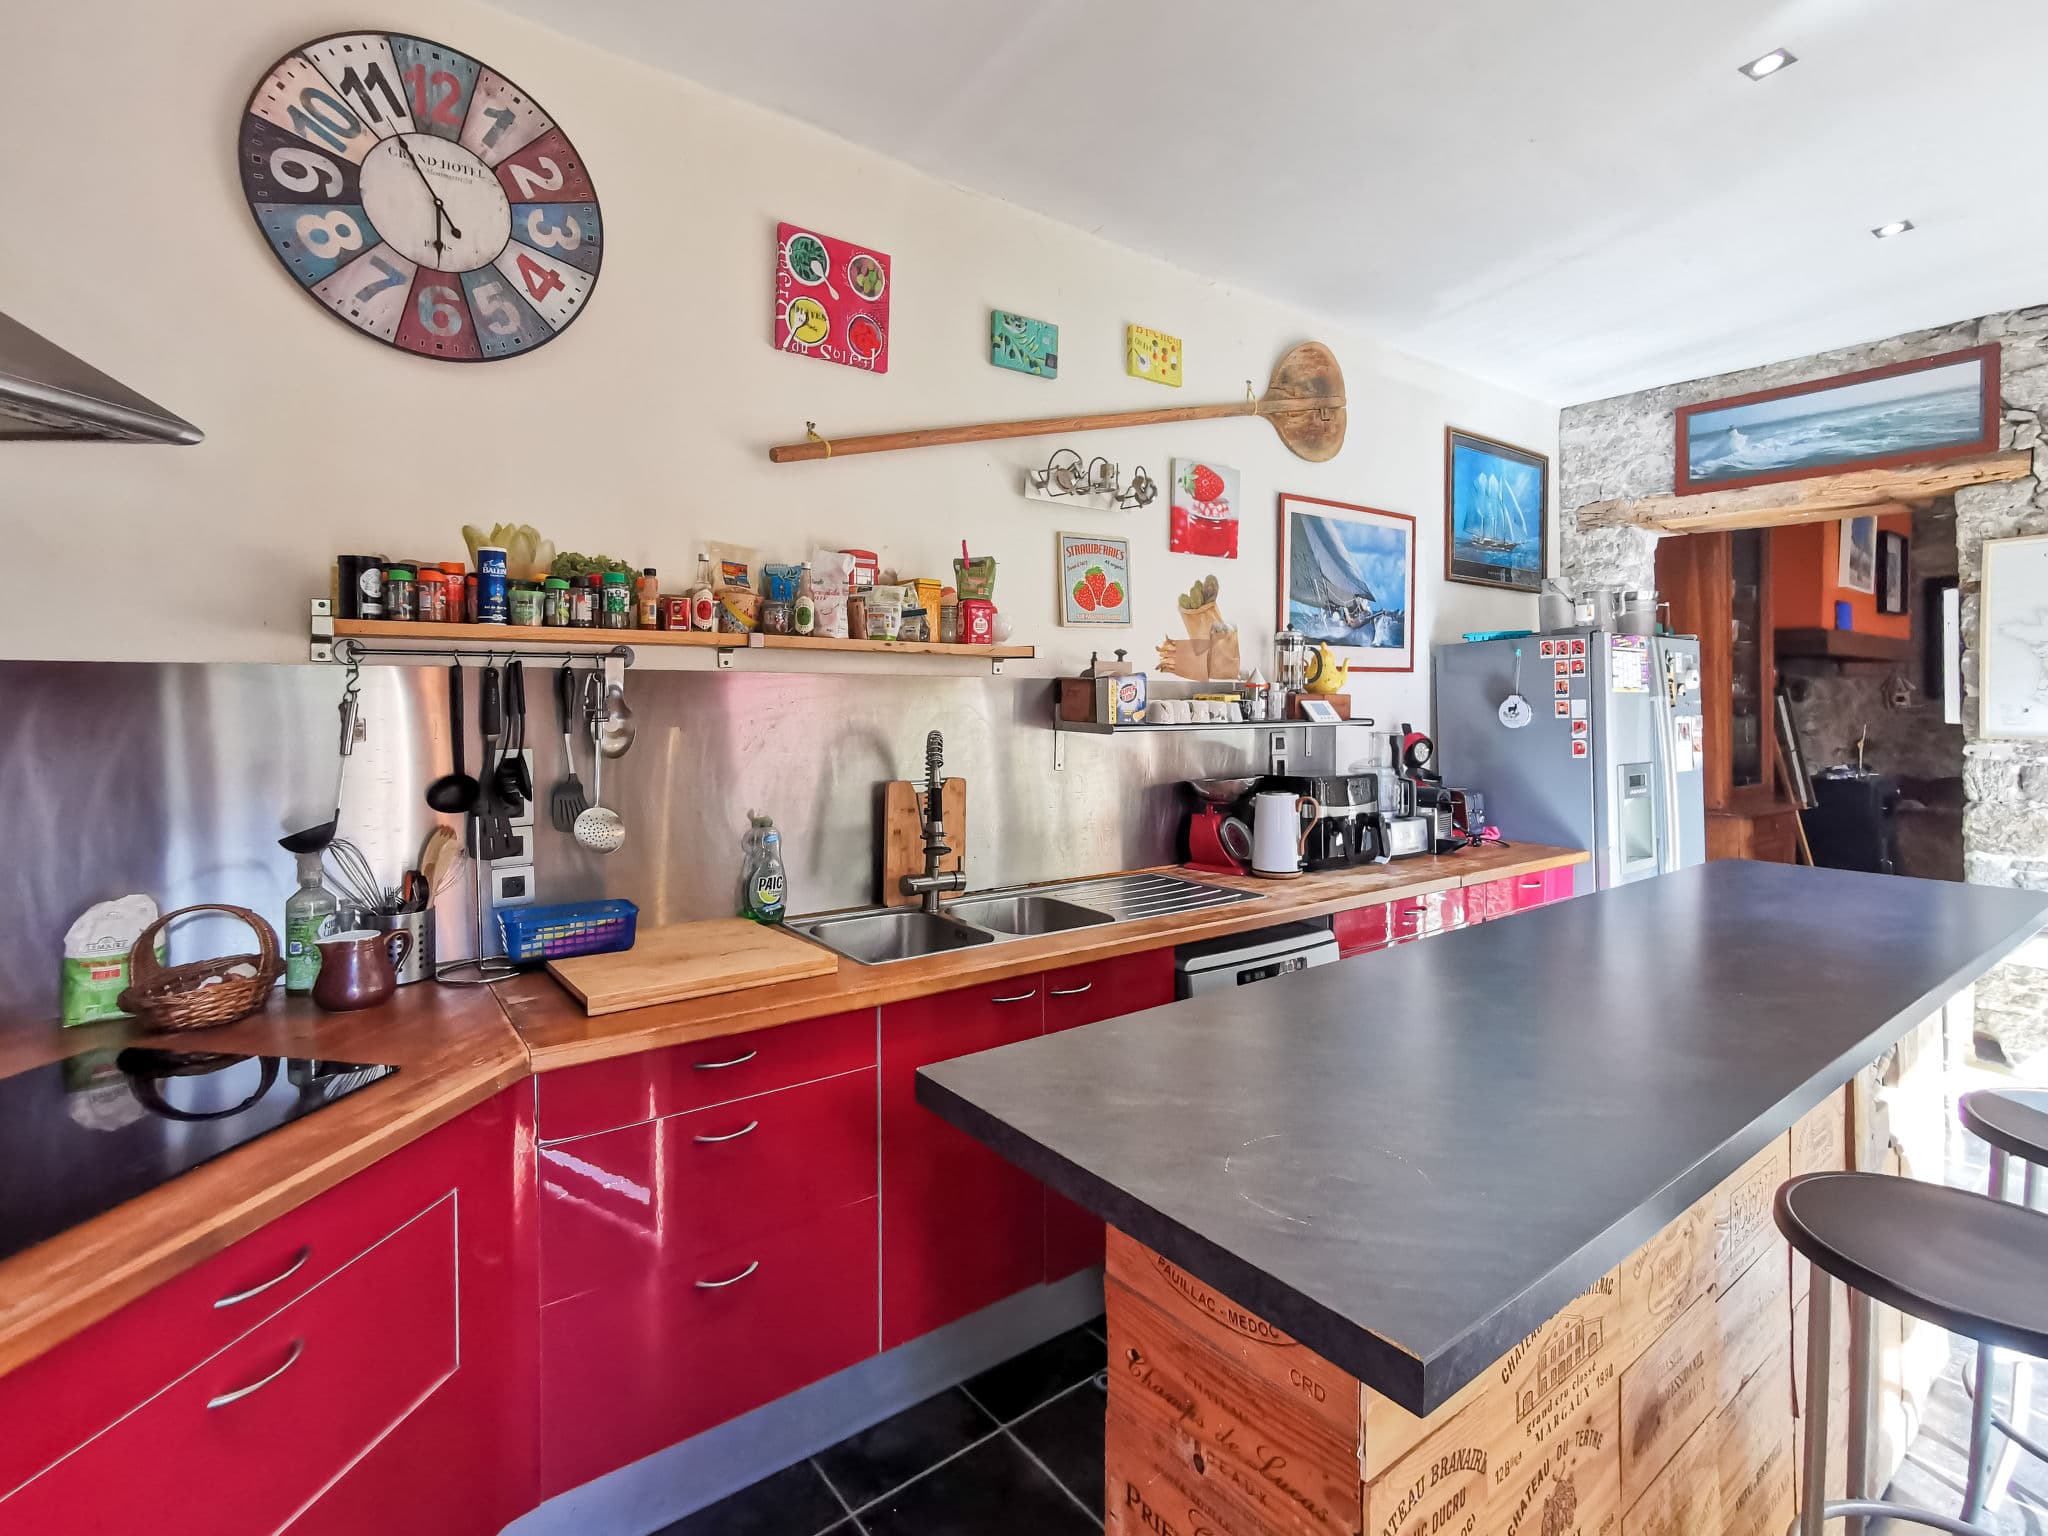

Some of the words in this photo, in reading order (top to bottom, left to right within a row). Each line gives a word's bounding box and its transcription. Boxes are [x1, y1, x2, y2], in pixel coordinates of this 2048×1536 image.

[340, 62, 407, 123] 11
[405, 63, 462, 127] 12
[286, 87, 362, 153] 10
[482, 106, 516, 149] 1
[269, 147, 343, 198] 9
[441, 159, 486, 180] HOTEL
[508, 156, 563, 199] 2
[296, 210, 363, 259] 8
[424, 239, 452, 252] PIS
[527, 208, 581, 250] 3
[355, 255, 407, 303] 7
[516, 253, 565, 302] 4
[418, 285, 462, 337] 6
[472, 281, 521, 336] 5
[791, 341, 808, 353] du
[820, 343, 875, 370] Soleil
[1065, 543, 1125, 561] STRAWBERRIES
[758, 875, 783, 891] PAIC
[1157, 1255, 1216, 1313] PAUILLAC
[1228, 1308, 1280, 1339] MEDOC
[1290, 1369, 1326, 1403] CRD
[1526, 1399, 1553, 1437] grand
[1554, 1385, 1569, 1407] cru
[1535, 1385, 1590, 1444] MARGAUX
[1507, 1458, 1550, 1536] CHATEAU
[1556, 1438, 1569, 1461] DU
[1575, 1428, 1603, 1450] TERTRE
[1431, 1486, 1466, 1535] DUCRU
